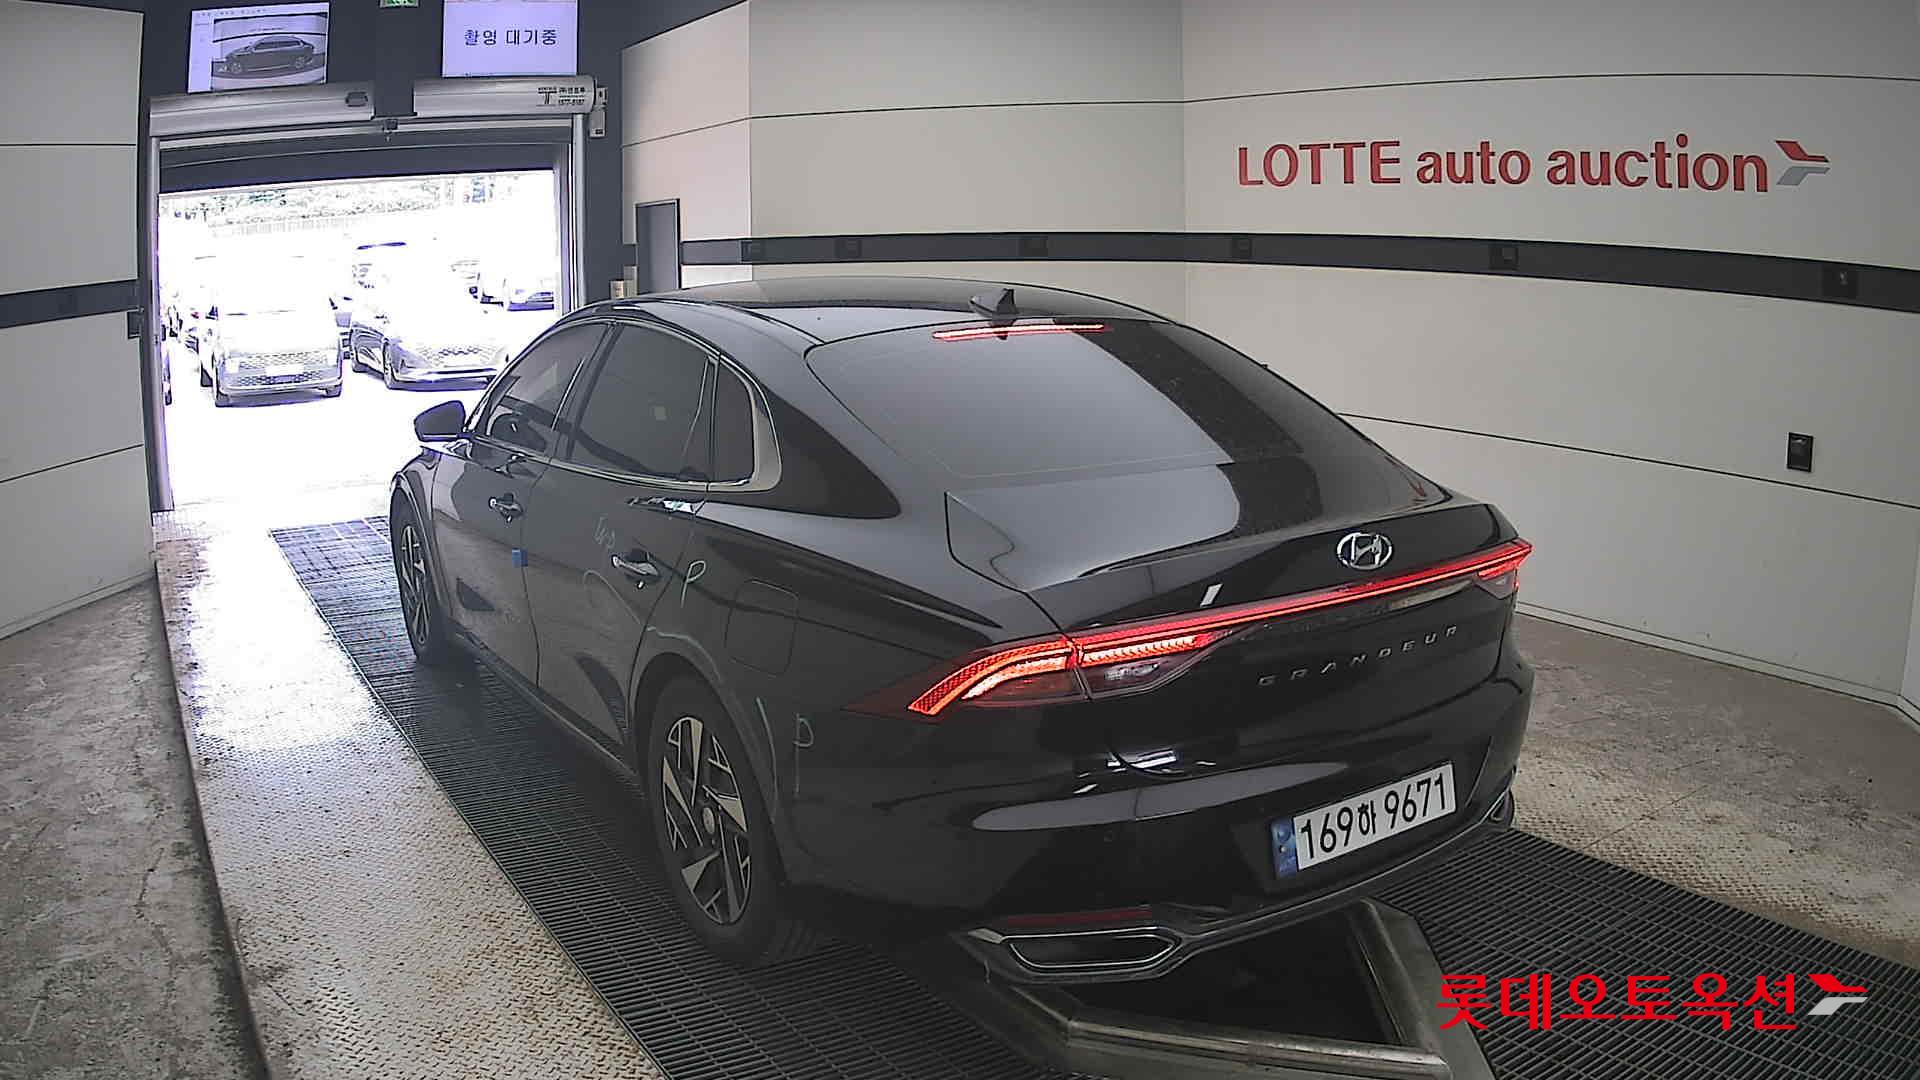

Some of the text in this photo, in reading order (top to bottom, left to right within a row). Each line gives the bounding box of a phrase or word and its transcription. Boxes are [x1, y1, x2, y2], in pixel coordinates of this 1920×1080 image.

[506, 29, 558, 46] 대기중
[1237, 133, 1768, 193] LOTTE auto auction
[1258, 624, 1458, 687] GRANDEUR
[1300, 772, 1446, 860] 169하 9671
